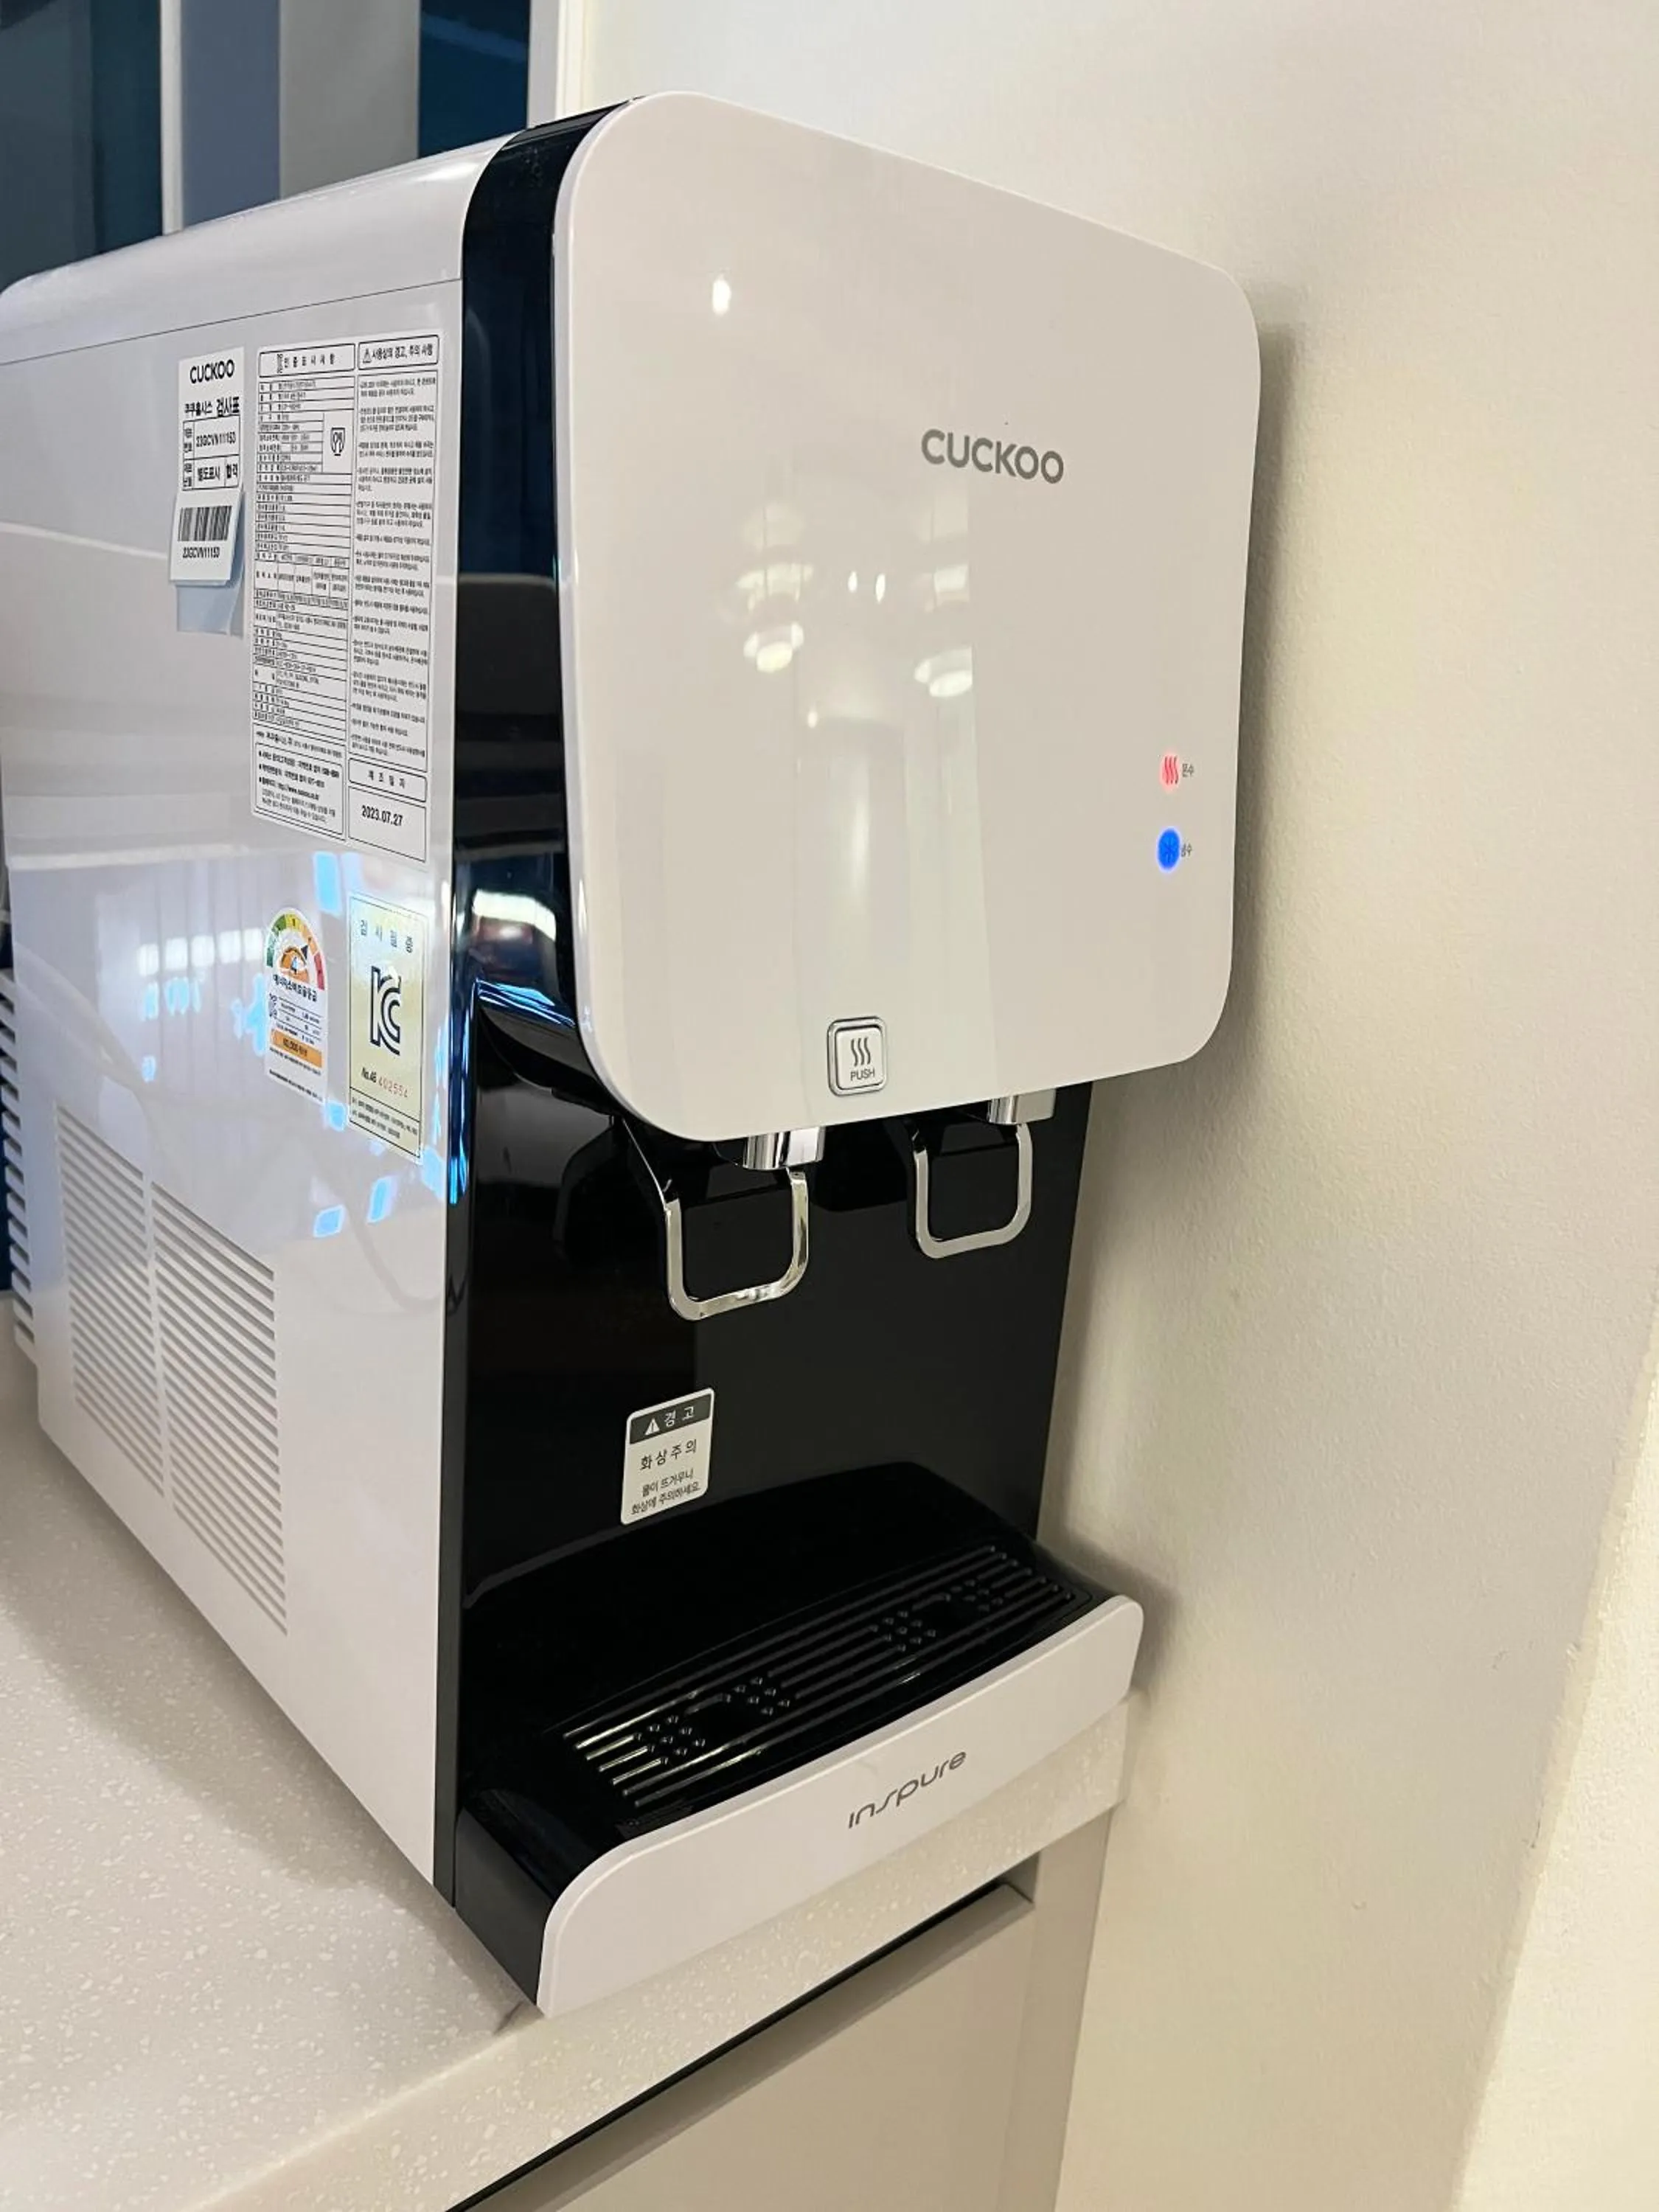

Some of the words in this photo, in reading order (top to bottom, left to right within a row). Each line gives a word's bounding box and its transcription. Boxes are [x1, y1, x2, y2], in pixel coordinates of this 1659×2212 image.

[189, 358, 235, 384] CUCKOO
[921, 428, 1064, 484] CUCKOO
[362, 804, 403, 827] 2023.07.27
[850, 1067, 875, 1082] PUSH
[631, 1493, 657, 1515] 화상에
[658, 1481, 701, 1504] 주의하세요
[848, 1751, 967, 1829] inspure
